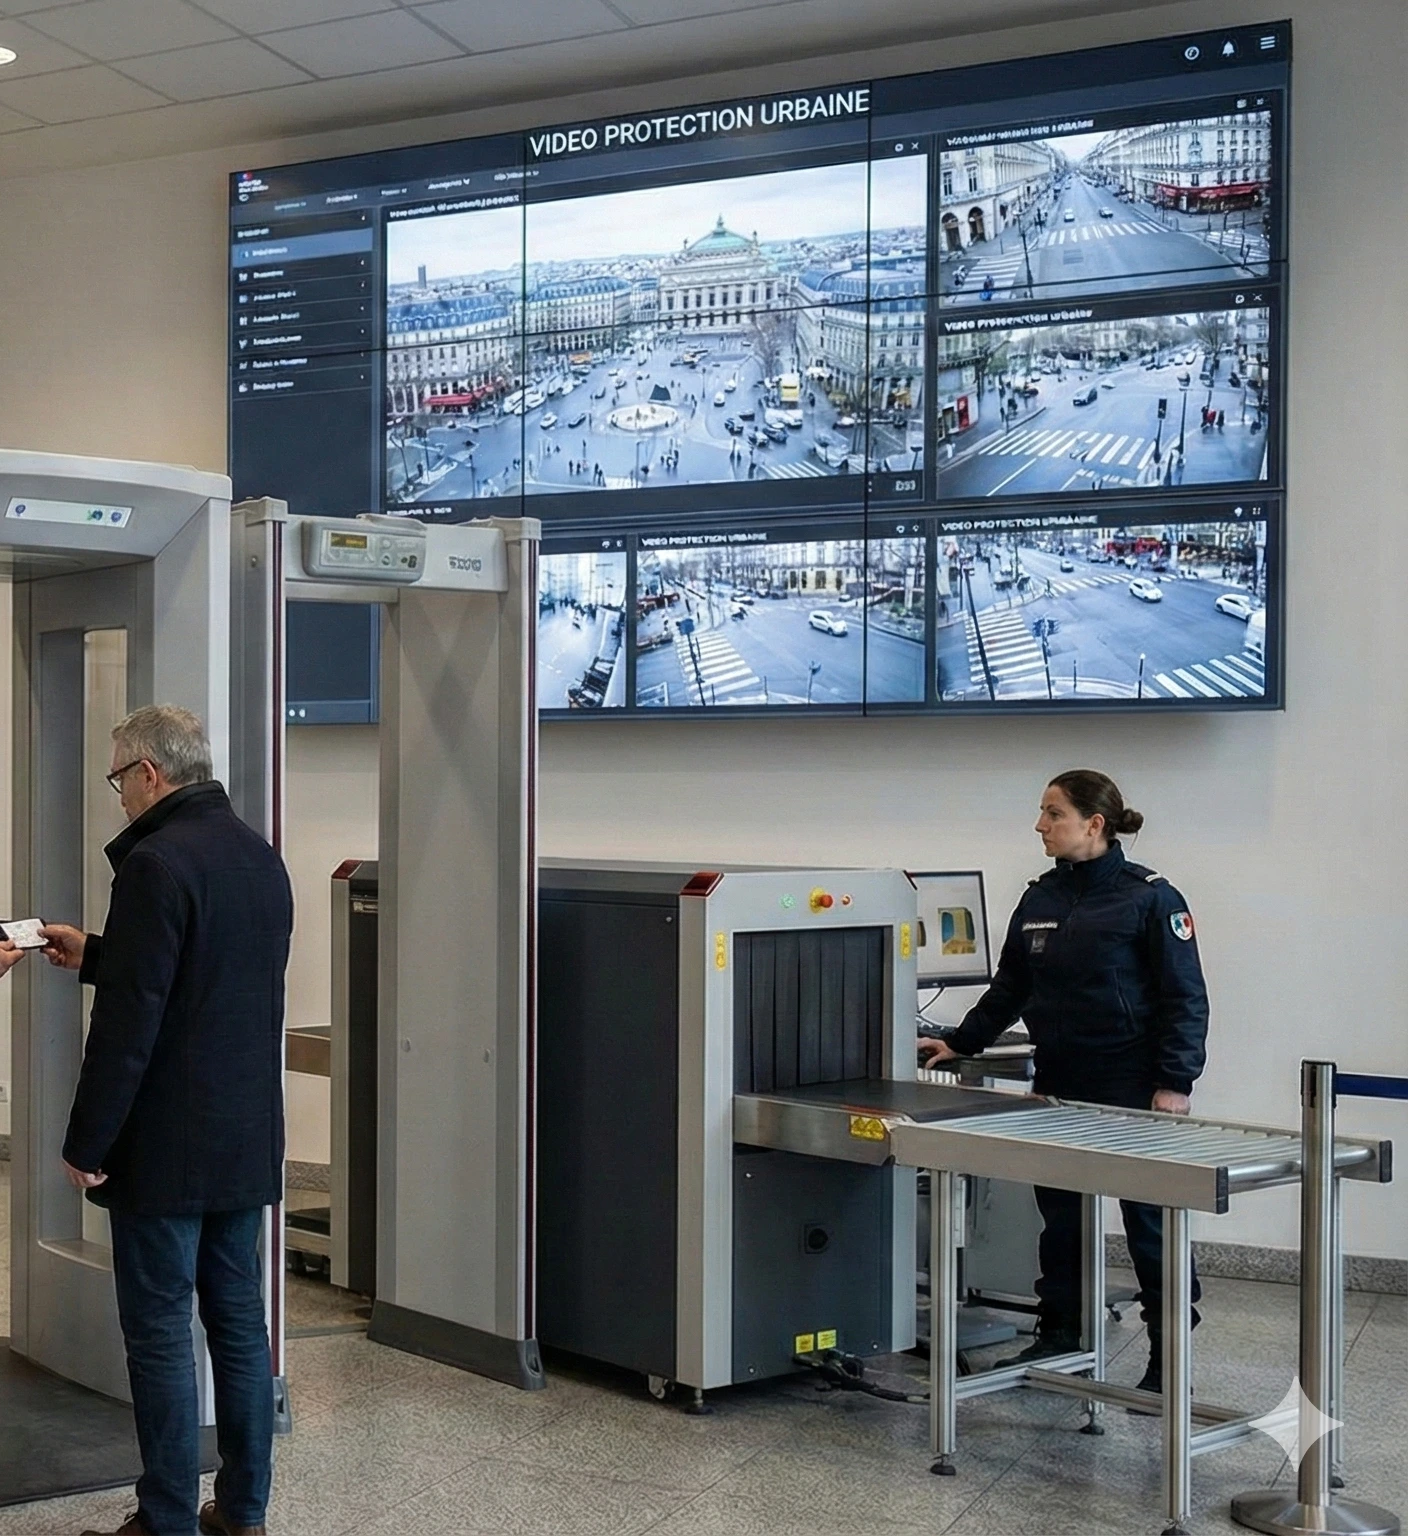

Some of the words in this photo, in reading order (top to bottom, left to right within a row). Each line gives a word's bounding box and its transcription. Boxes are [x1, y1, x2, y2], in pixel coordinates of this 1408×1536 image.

[530, 128, 598, 157] VIDEO
[605, 105, 753, 147] PROTECTION
[760, 89, 870, 125] URBAINE
